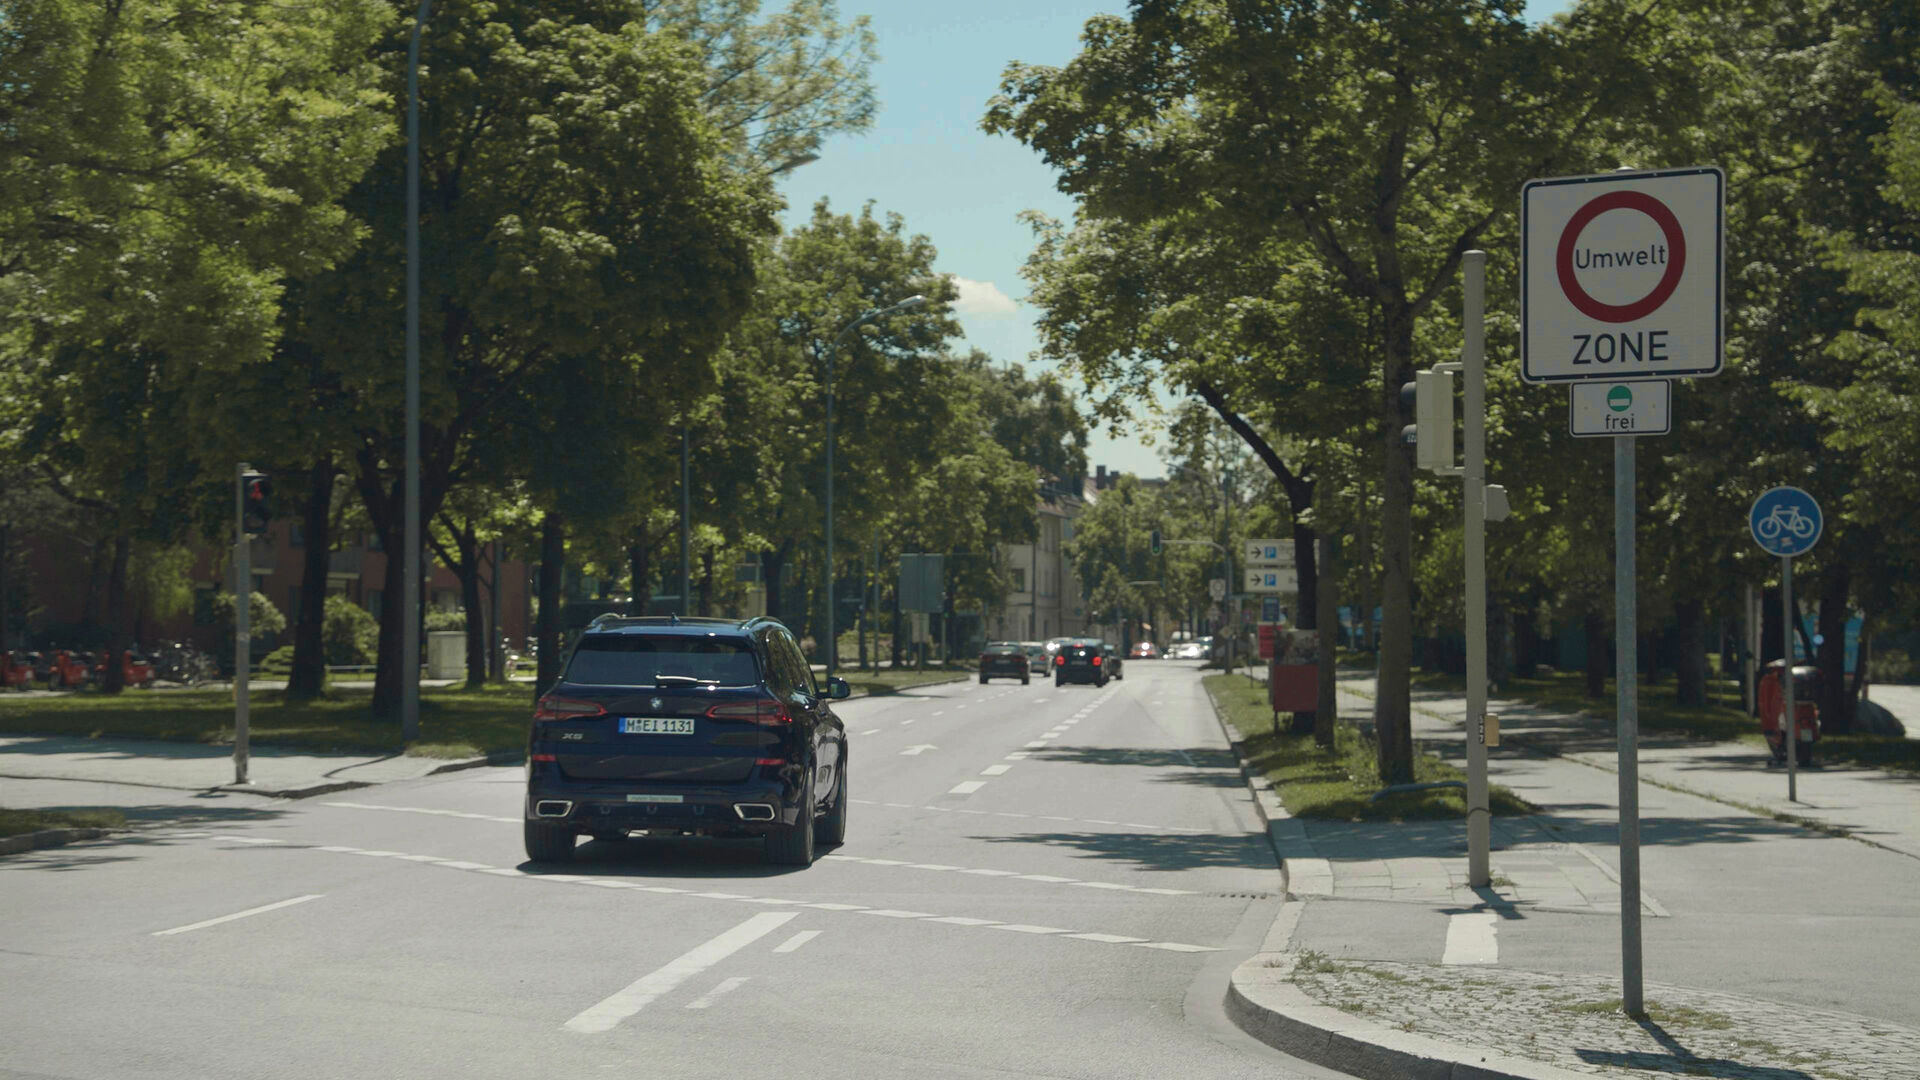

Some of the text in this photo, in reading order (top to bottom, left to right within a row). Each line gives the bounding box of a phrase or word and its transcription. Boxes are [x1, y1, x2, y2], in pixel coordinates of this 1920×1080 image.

[1575, 245, 1666, 269] Umwelt
[1572, 330, 1669, 365] ZONE
[1605, 413, 1635, 430] frei
[662, 720, 694, 733] 1131
